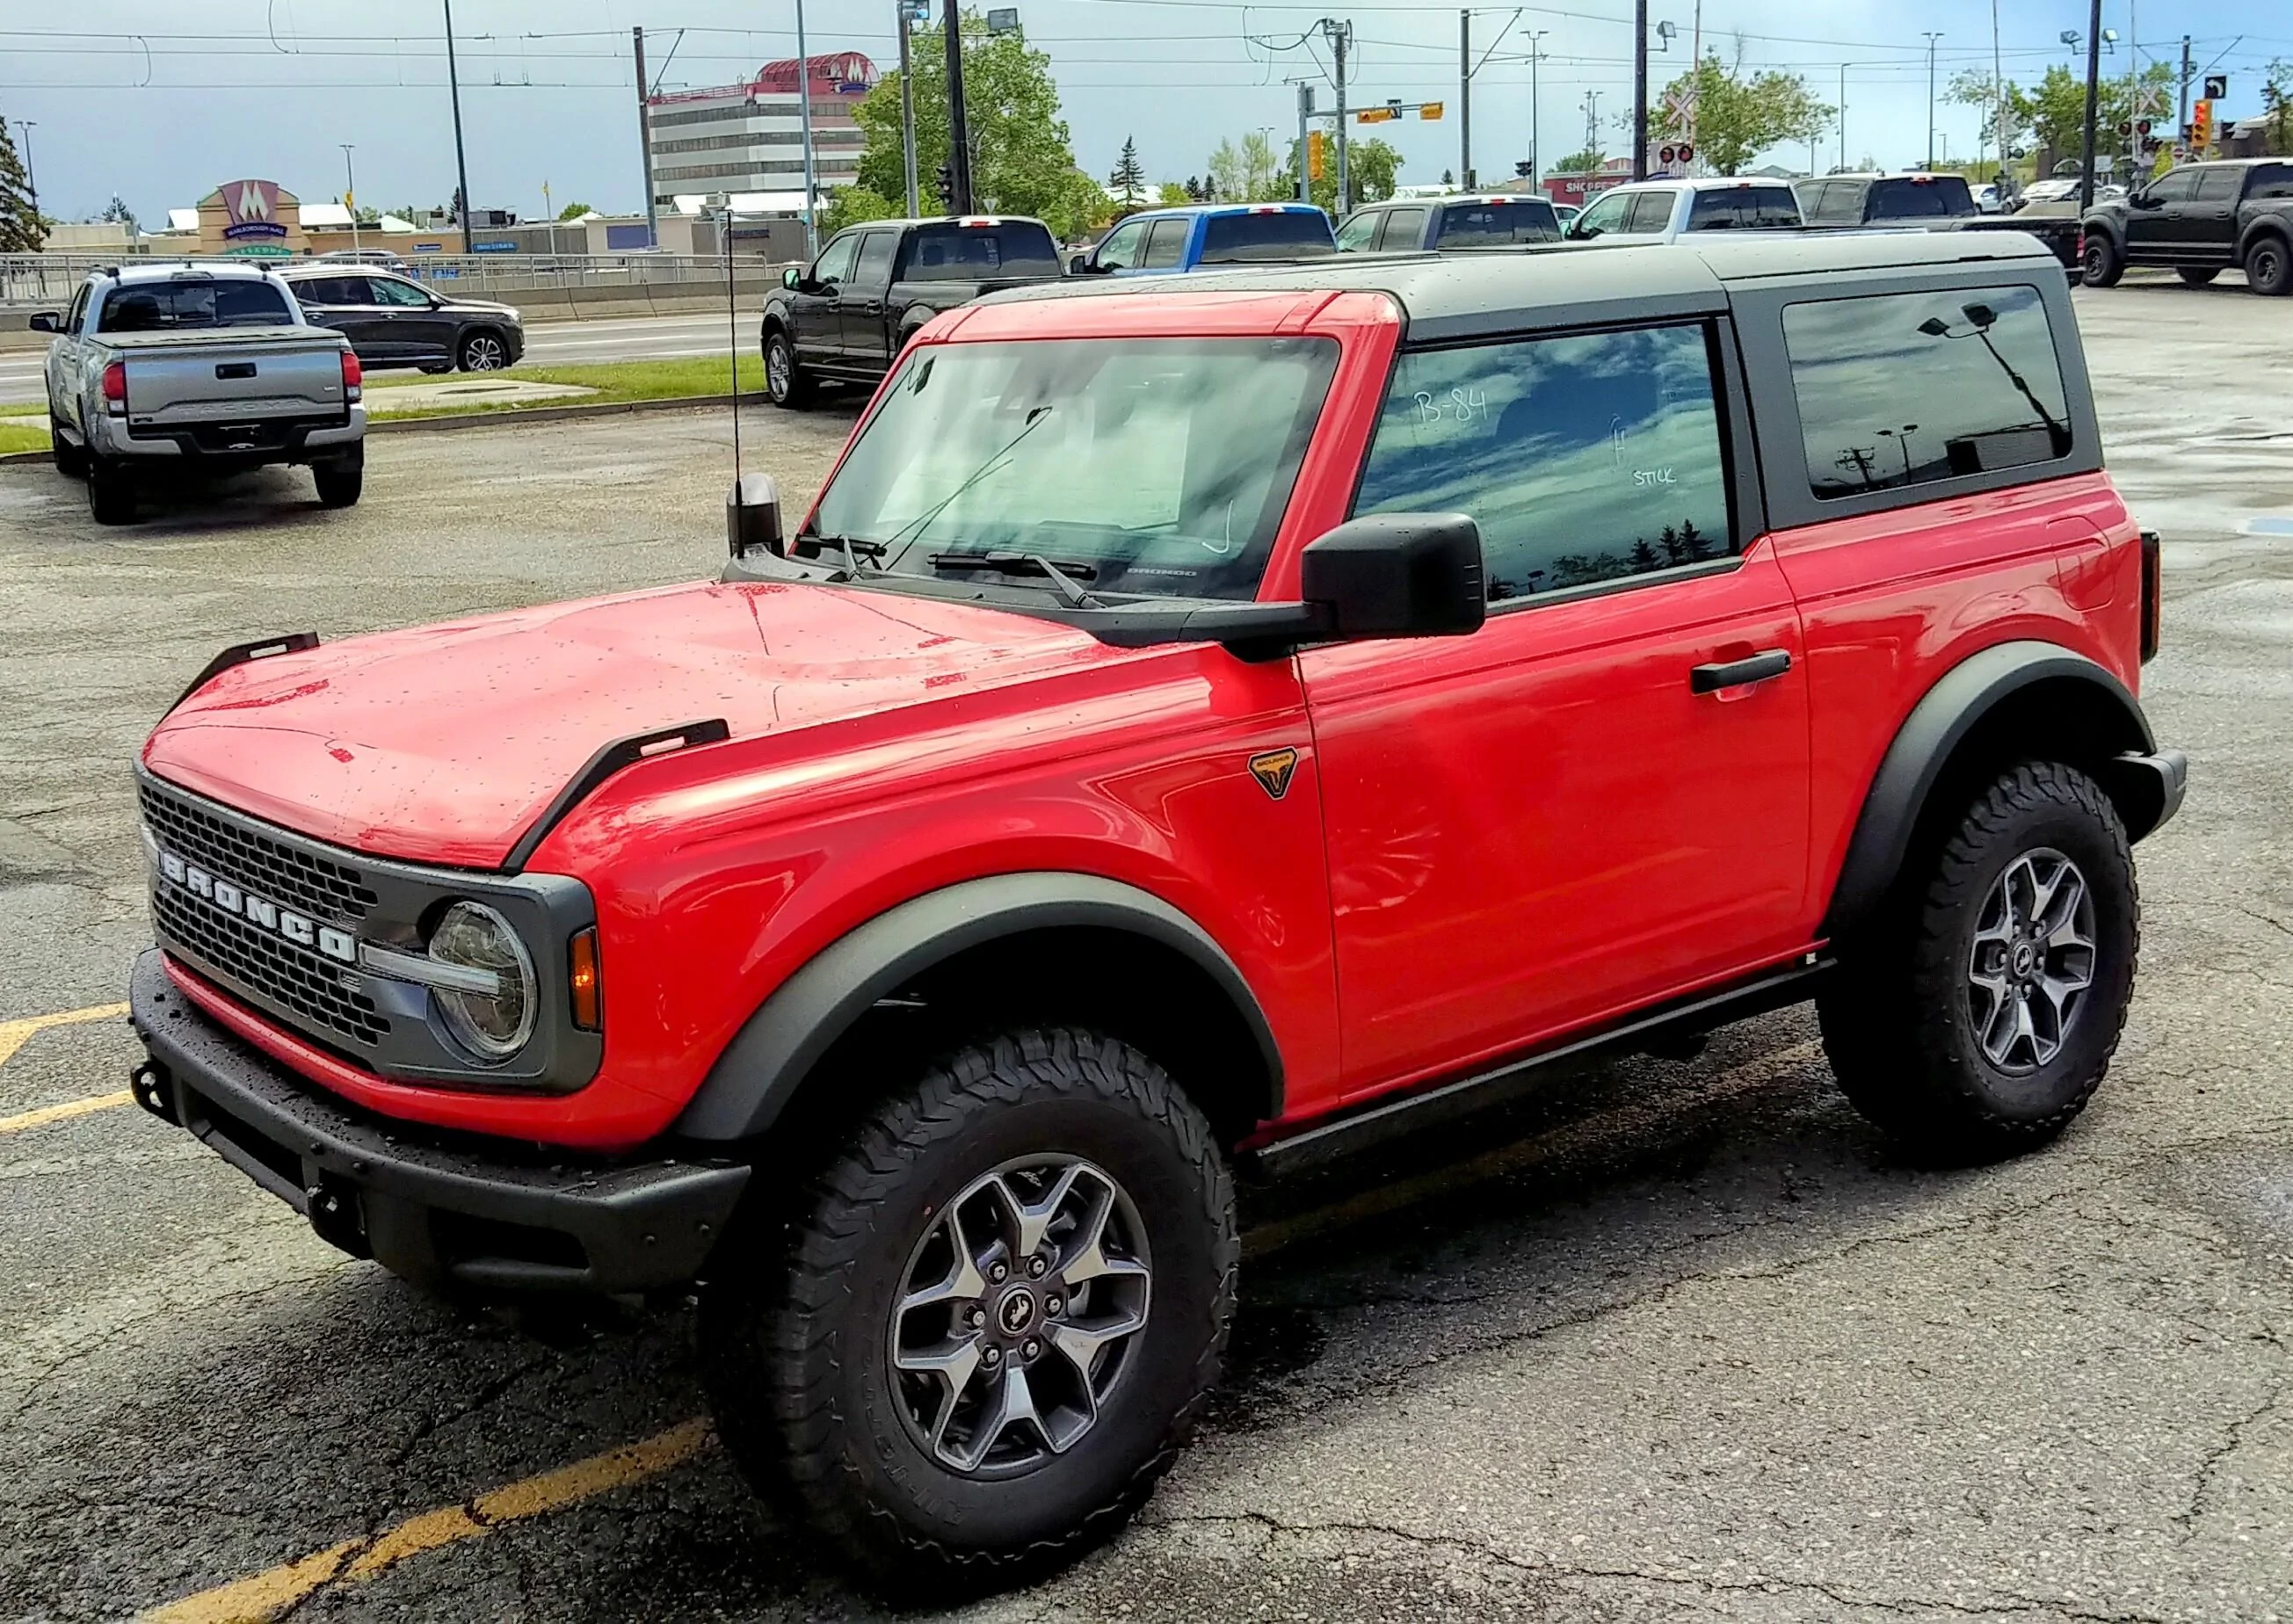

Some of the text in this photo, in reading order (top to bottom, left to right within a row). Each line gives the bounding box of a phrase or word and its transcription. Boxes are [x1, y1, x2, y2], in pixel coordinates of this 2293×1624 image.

[238, 181, 268, 222] M
[178, 401, 301, 414] TACOMA
[1413, 388, 1488, 423] B-84
[1632, 467, 1678, 486] STICK
[1127, 567, 1197, 576] BRONCO
[162, 852, 356, 962] BRONCO
